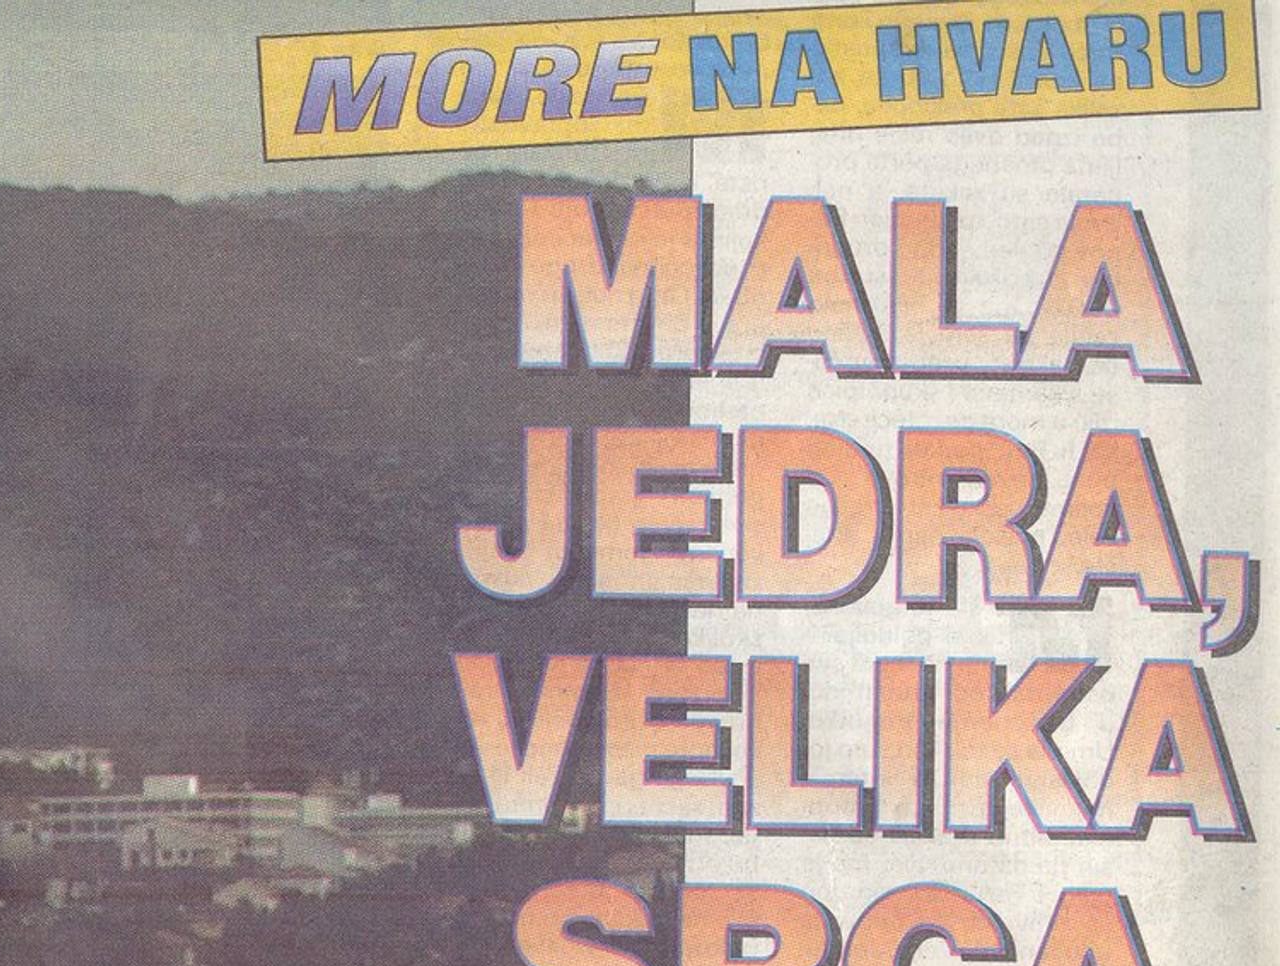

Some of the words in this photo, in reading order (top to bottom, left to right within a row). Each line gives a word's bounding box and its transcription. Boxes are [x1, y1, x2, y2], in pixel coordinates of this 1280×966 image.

[294, 40, 660, 135] MORE
[689, 30, 843, 112] NA
[876, 11, 1229, 103] HVARU
[519, 194, 1201, 384] MALA
[457, 424, 1261, 657] JEDRA,
[451, 653, 1257, 843] VELIKA
